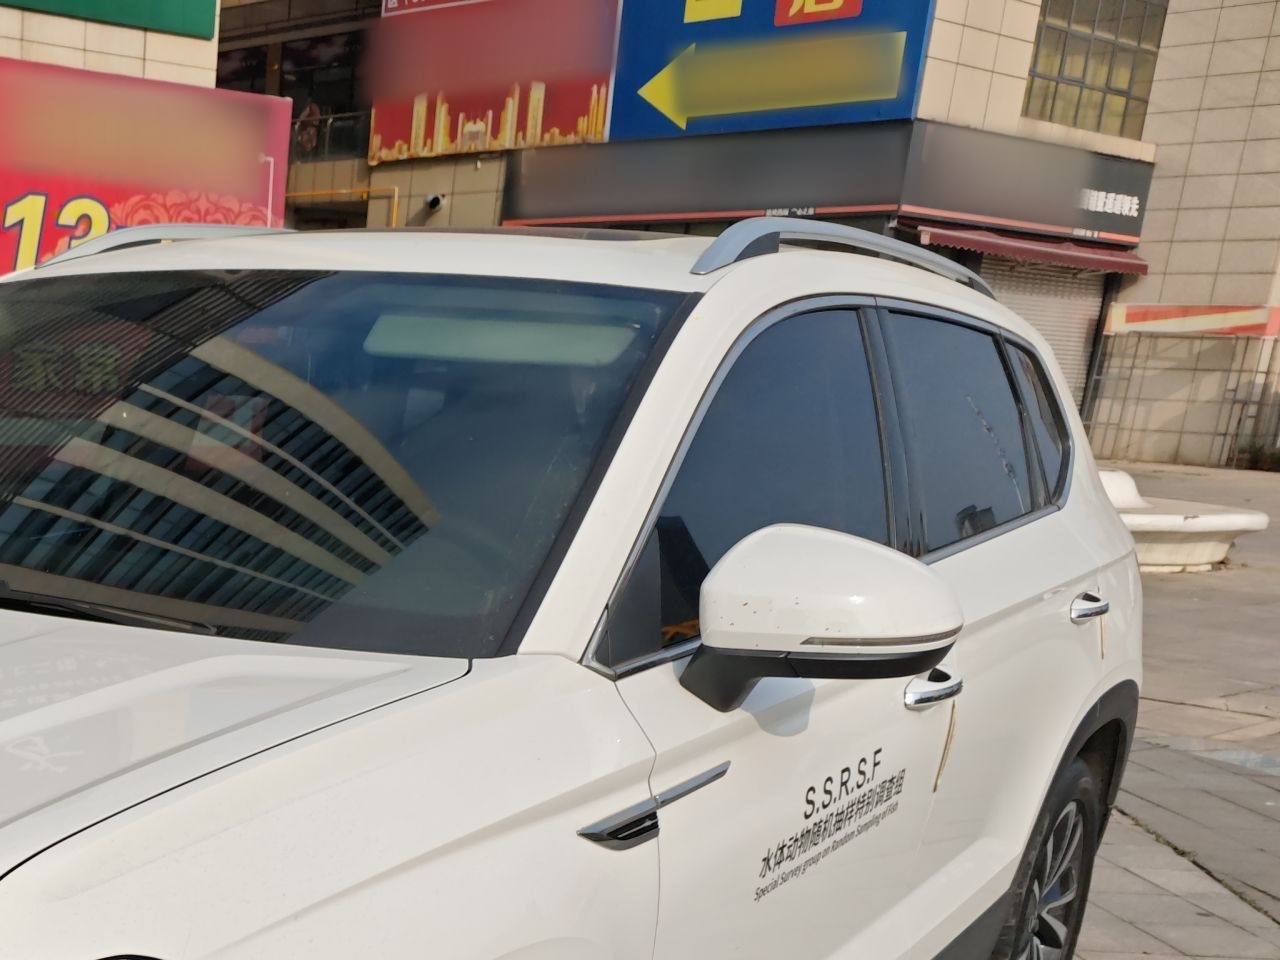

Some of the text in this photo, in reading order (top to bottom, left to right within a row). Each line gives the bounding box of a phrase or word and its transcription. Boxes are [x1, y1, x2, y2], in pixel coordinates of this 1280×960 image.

[804, 747, 883, 820] S.S.R.S.F
[754, 874, 780, 902] Special
[779, 863, 802, 885] Survey
[802, 852, 822, 875] group
[831, 832, 855, 852] Random
